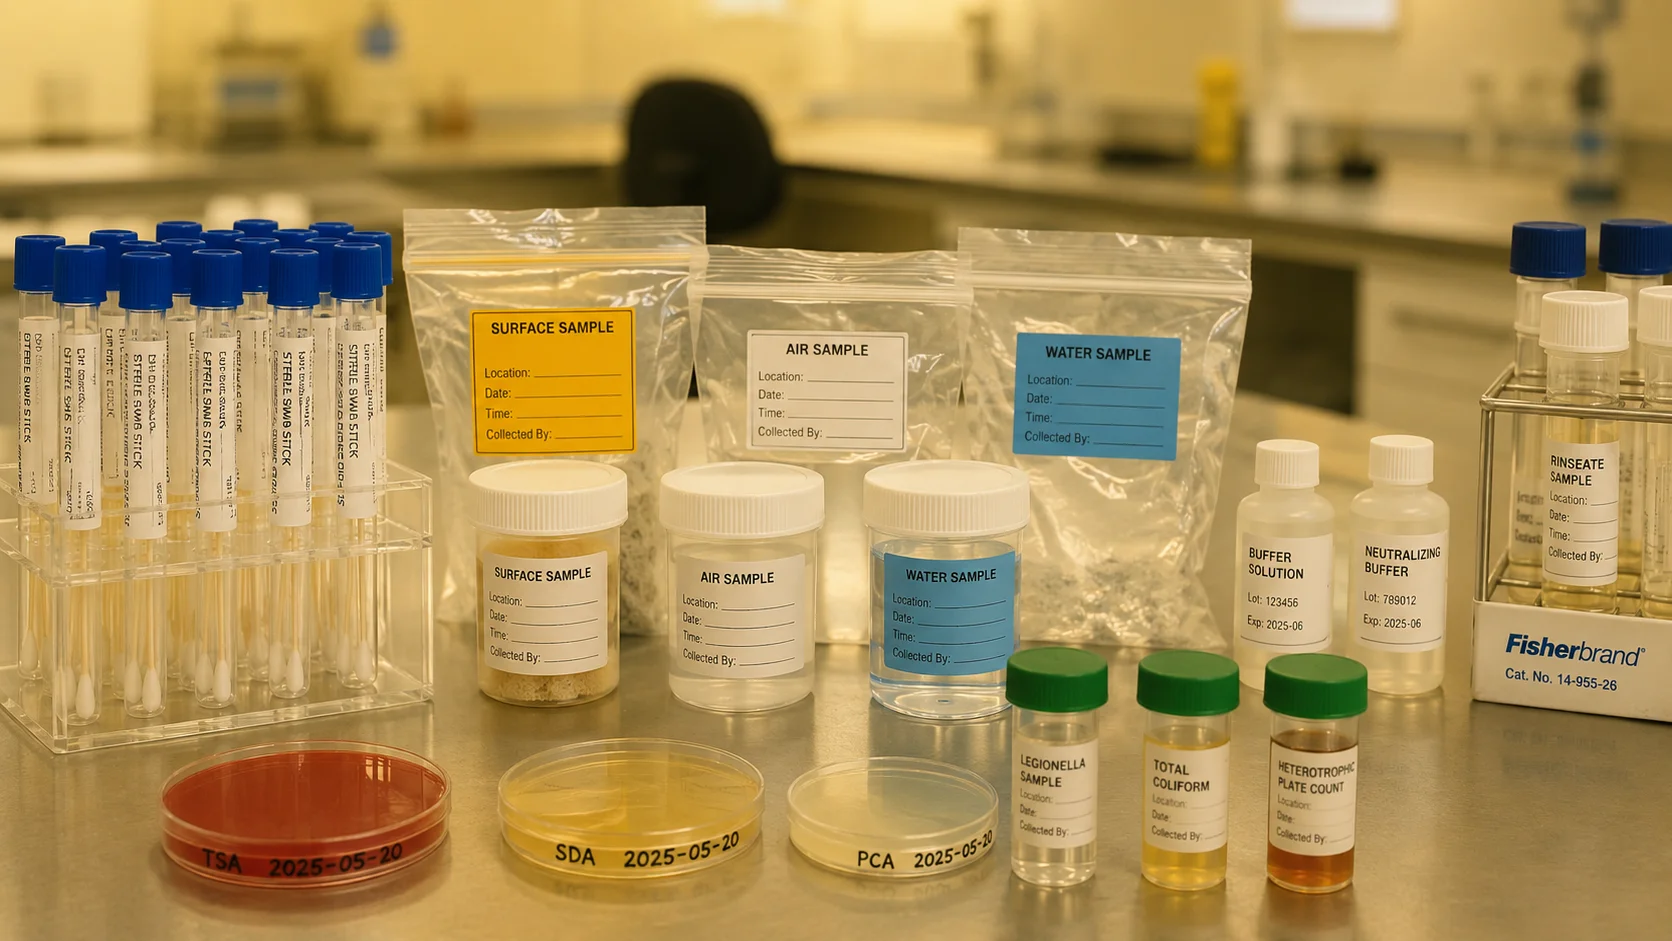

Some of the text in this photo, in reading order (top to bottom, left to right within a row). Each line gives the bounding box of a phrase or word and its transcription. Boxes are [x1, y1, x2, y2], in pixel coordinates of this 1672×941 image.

[491, 321, 614, 334] SURFACE SAMPLE
[786, 343, 869, 356] AIR SAMPLE
[1046, 346, 1152, 362] WATER SAMPLE
[484, 368, 531, 378] Location:
[758, 371, 804, 382] Location:
[1028, 374, 1073, 386] Location:
[485, 387, 512, 399] Date:
[758, 389, 784, 400] Date:
[1026, 393, 1052, 404] Date:
[485, 408, 513, 419] Time:
[758, 408, 785, 418] Time:
[1025, 412, 1053, 423] Time:
[348, 424, 358, 458] STICK
[486, 428, 552, 442] Collected By:
[758, 426, 823, 440] Collected By:
[1024, 430, 1090, 446] Collected By:
[282, 431, 292, 466] STICK
[1550, 455, 1605, 470] RINSEATE
[1550, 471, 1592, 486] SAMPLE
[1550, 490, 1588, 506] Location:
[1549, 509, 1570, 523] Date:
[1549, 527, 1571, 541] Time:
[1249, 547, 1292, 563] BUFFER
[1365, 545, 1441, 561] NEUTRALIZING
[1548, 546, 1603, 564] Collected By:
[494, 566, 592, 582] SURFACE SAMPLE
[906, 568, 996, 583] WATER SAMPLE
[1248, 564, 1304, 580] SOLUTION
[1365, 562, 1409, 577] BUFFER
[700, 571, 774, 585] AIR SAMPLE
[489, 591, 522, 606] Location:
[682, 594, 718, 610] Location:
[892, 593, 932, 608] Location:
[1248, 592, 1299, 608] Lot: 123456
[1364, 590, 1416, 606] Lot: 789012
[490, 609, 508, 622] Date:
[682, 612, 702, 625] Date:
[892, 611, 914, 624] Date:
[1248, 614, 1304, 630] Exp: 2025-06
[1363, 614, 1422, 629] Exp: 2025-06
[490, 627, 508, 640] Time:
[683, 630, 702, 644] Time:
[892, 629, 916, 642] Time:
[490, 645, 540, 665] Collected By:
[683, 648, 736, 668] Collected By:
[892, 648, 950, 666] Collected By:
[1505, 668, 1618, 692] Cat. No. 14-955-26
[1020, 754, 1086, 771] LEGIONELLA
[1154, 759, 1190, 776] TOTAL
[1278, 760, 1355, 778] HETEROTROPHIC
[1020, 770, 1062, 788] SAMPLE
[1153, 776, 1210, 792] COLIFORM
[1278, 776, 1344, 794] PLATE COUNT
[1020, 788, 1053, 804] Location:
[1152, 793, 1188, 808] Location:
[1020, 820, 1069, 838] Collected By:
[1152, 825, 1203, 842] Collected By:
[1276, 826, 1328, 846] Collected By:
[555, 831, 740, 868] SDA 2025-05-20
[858, 830, 993, 870] PCA 2025-05-20
[202, 842, 403, 877] TSA 2025-05-20
